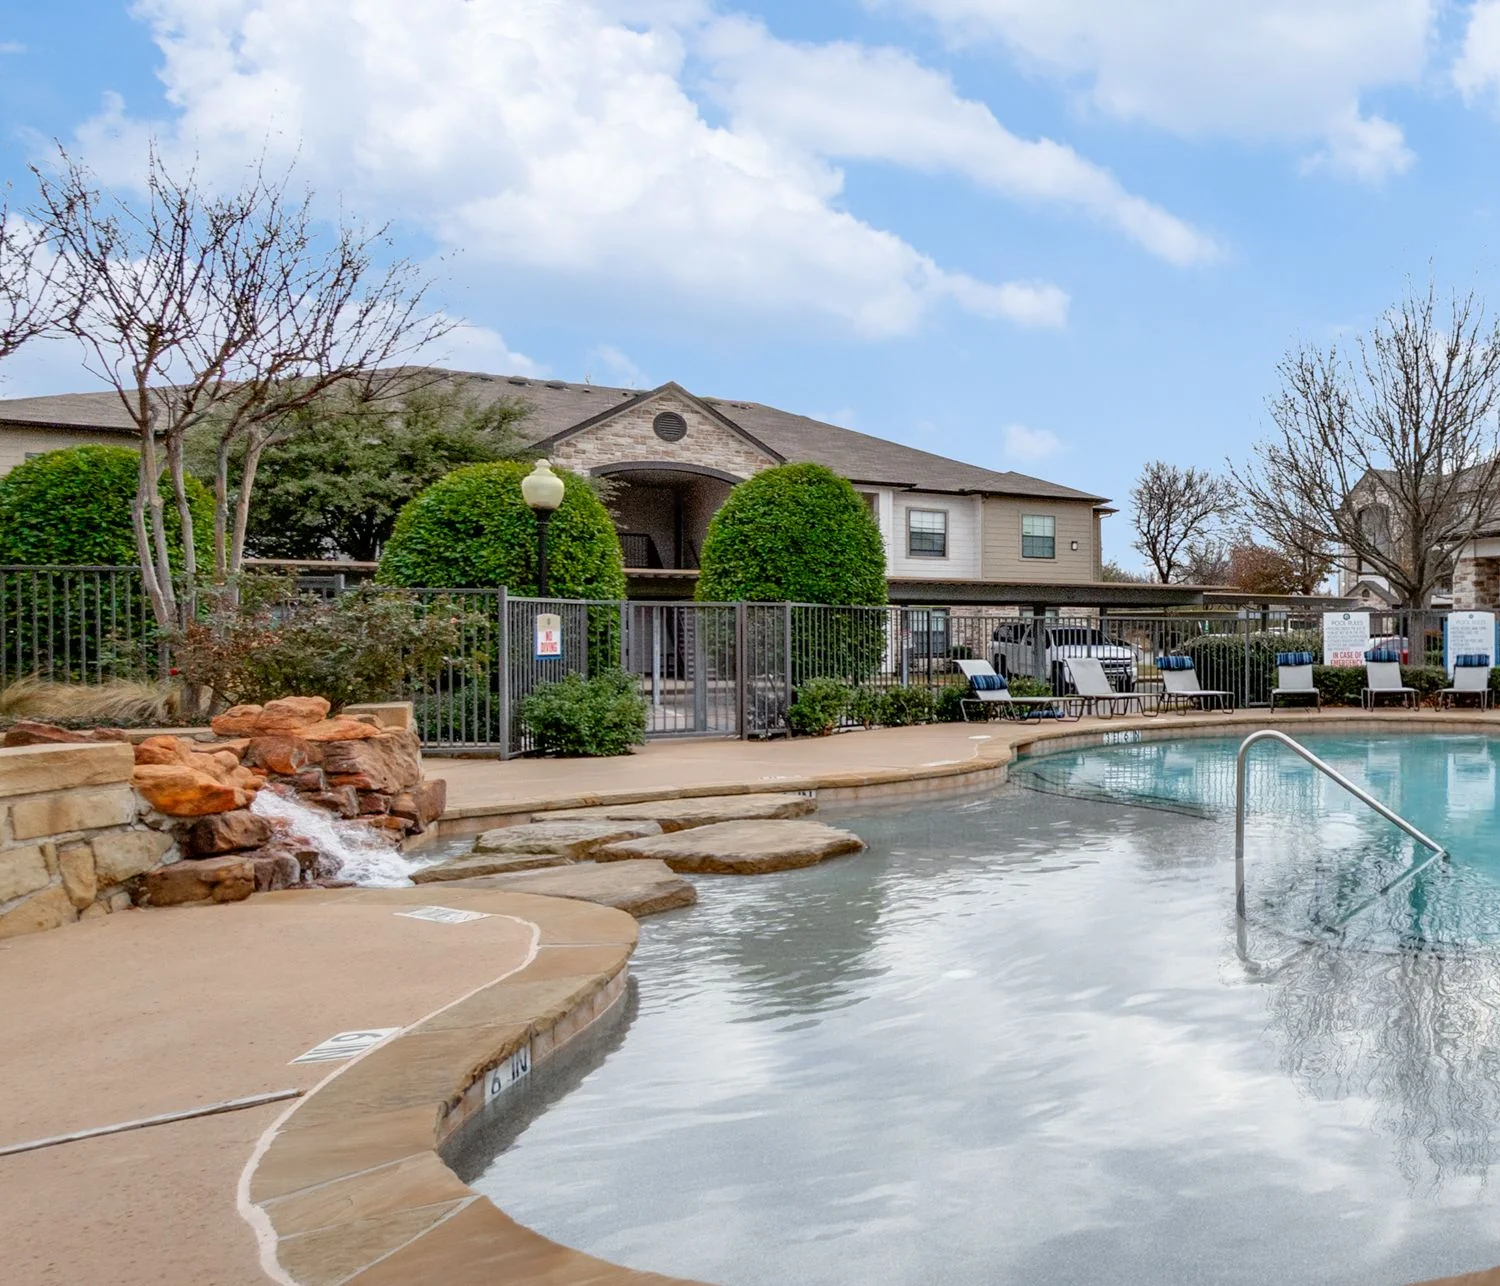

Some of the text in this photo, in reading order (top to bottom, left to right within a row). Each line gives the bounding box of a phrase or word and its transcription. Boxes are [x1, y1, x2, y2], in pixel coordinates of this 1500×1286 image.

[545, 631, 552, 641] NO
[541, 642, 557, 652] DIVING
[292, 1032, 384, 1063] 6 IN
[491, 1047, 527, 1095] 6 IN
